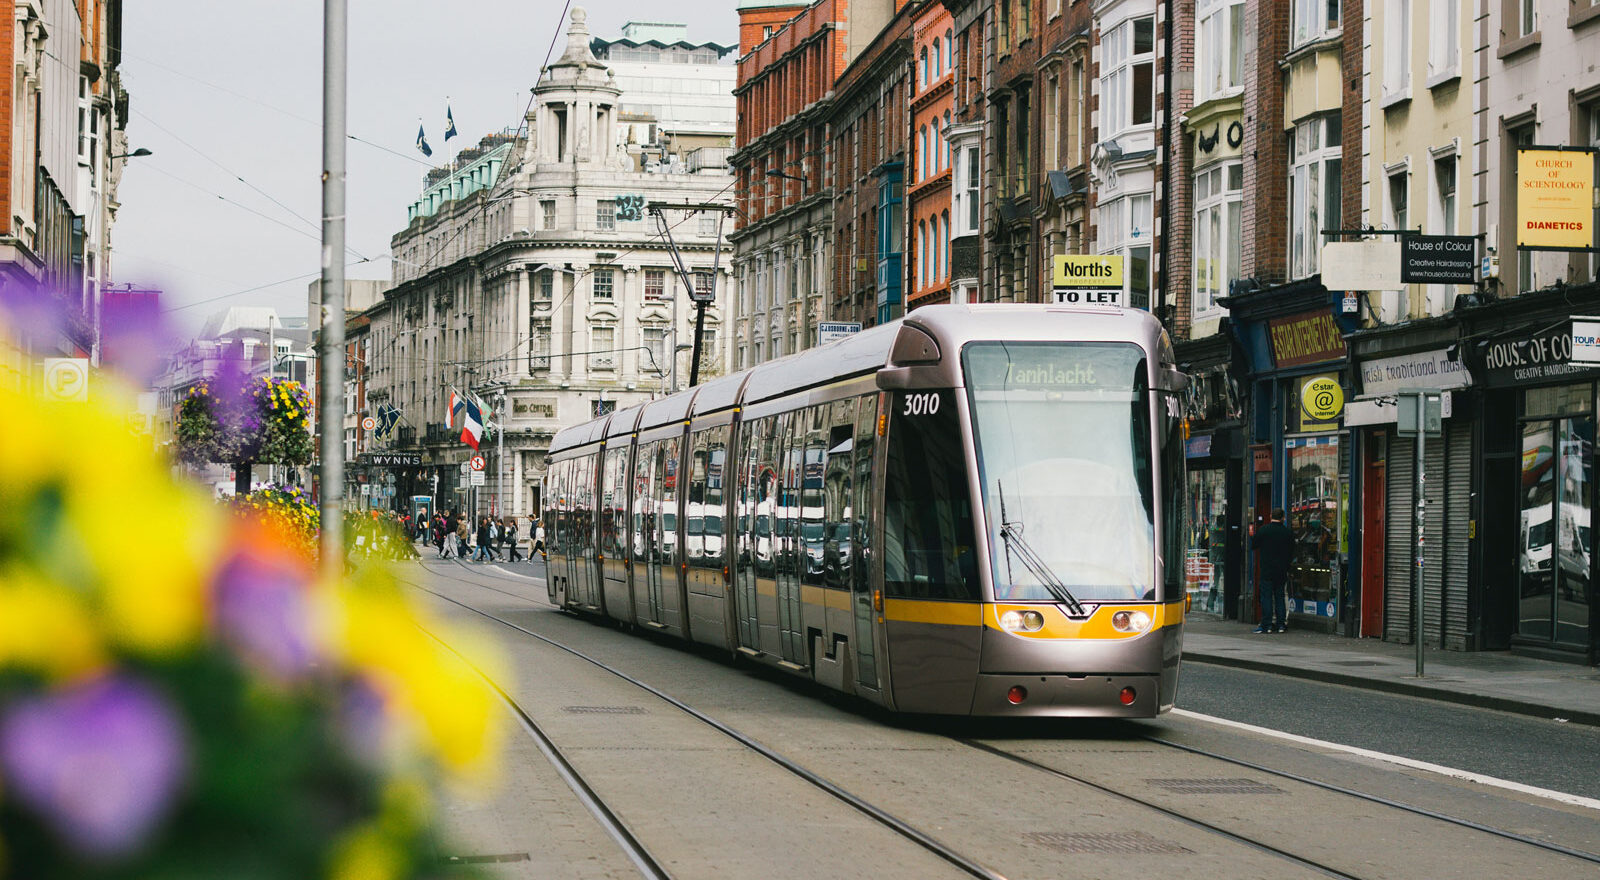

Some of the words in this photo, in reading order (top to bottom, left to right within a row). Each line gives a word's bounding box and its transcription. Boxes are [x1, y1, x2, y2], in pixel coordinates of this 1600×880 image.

[1535, 159, 1573, 168] CHURCH
[1548, 170, 1559, 178] OF
[1524, 180, 1586, 190] SCIENTOLOGY
[1526, 221, 1583, 231] DIANETICS
[1408, 240, 1433, 251] House
[1435, 240, 1443, 251] of
[1445, 241, 1472, 251] Colour
[1064, 261, 1112, 277] Norths
[1409, 258, 1435, 267] Creative
[1436, 260, 1472, 269] Hairdressing
[1055, 292, 1080, 303] TO
[1086, 292, 1120, 303] LET
[1574, 336, 1595, 344] TOUR
[1486, 343, 1527, 369] HOUS
[1530, 337, 1548, 363] OF
[1551, 333, 1572, 360] CO
[1007, 362, 1097, 385] Tamhlacht
[1386, 356, 1438, 381] traditional
[1514, 367, 1543, 380] CREATIVE
[903, 392, 940, 416] 3010
[1314, 391, 1334, 410] @
[373, 456, 420, 464] WYNNS
